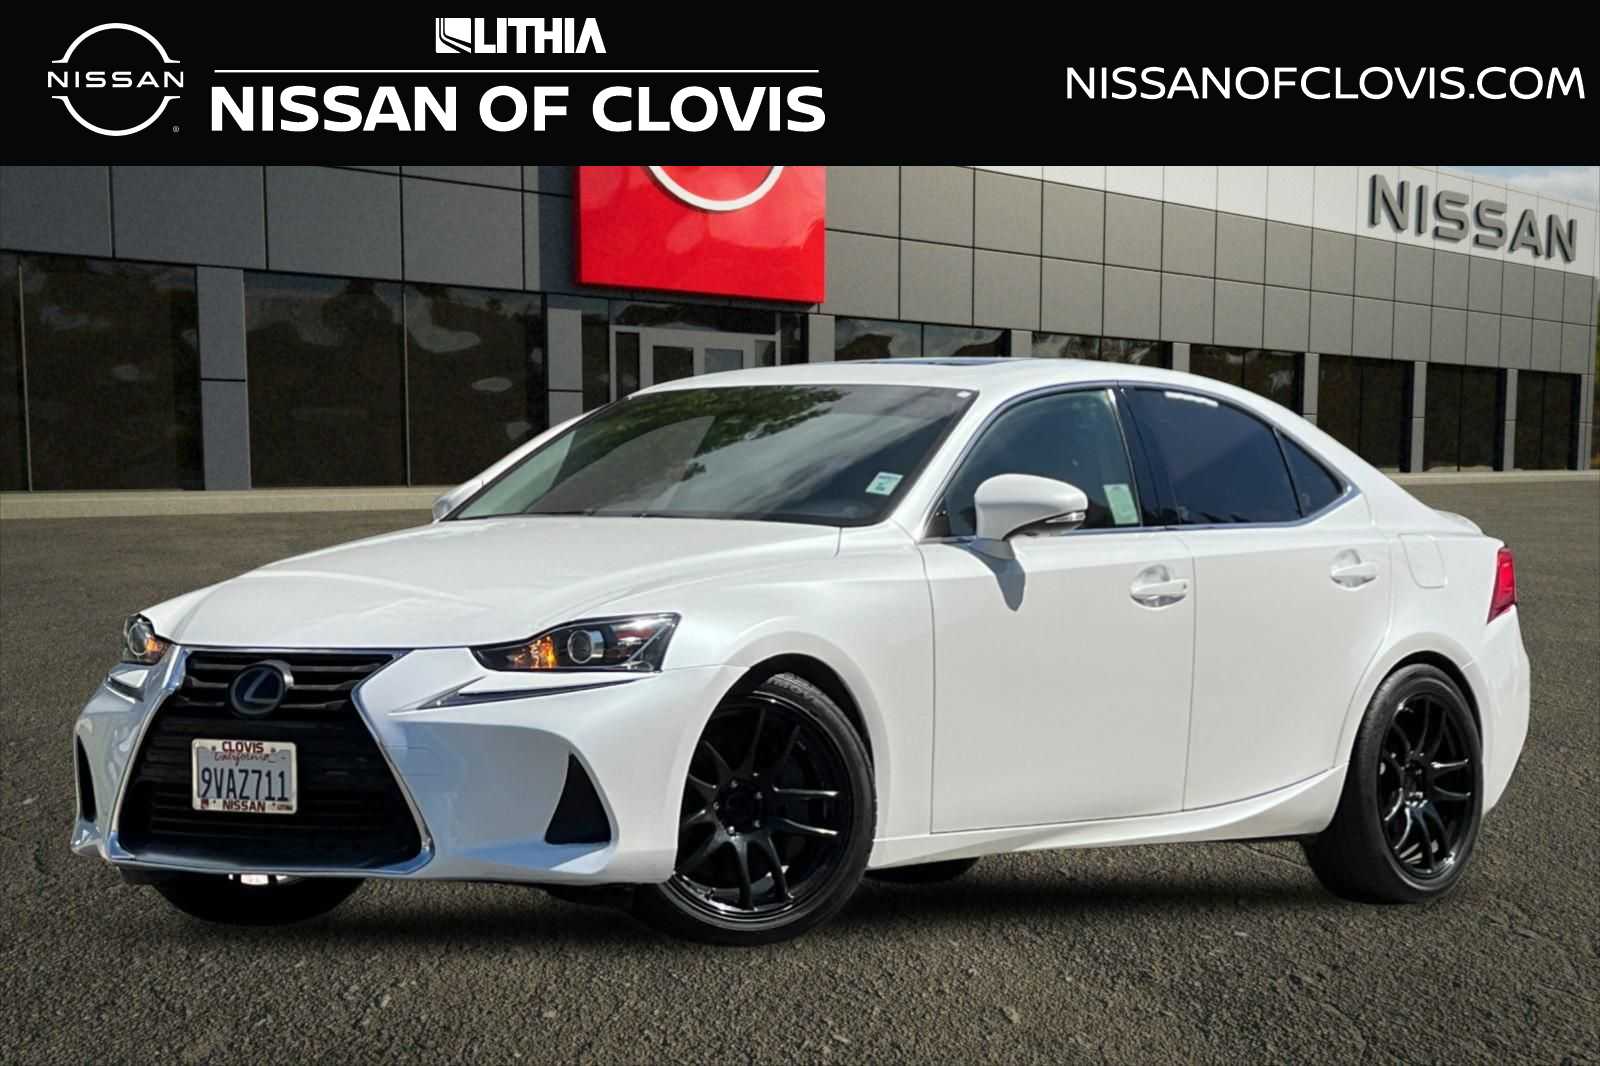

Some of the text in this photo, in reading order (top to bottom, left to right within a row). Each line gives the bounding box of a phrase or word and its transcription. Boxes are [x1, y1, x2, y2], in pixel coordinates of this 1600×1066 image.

[1368, 173, 1578, 264] NISSAN
[222, 741, 264, 753] CLOVIS
[201, 767, 289, 802] 9VAZ711
[223, 799, 265, 811] NISSAN
